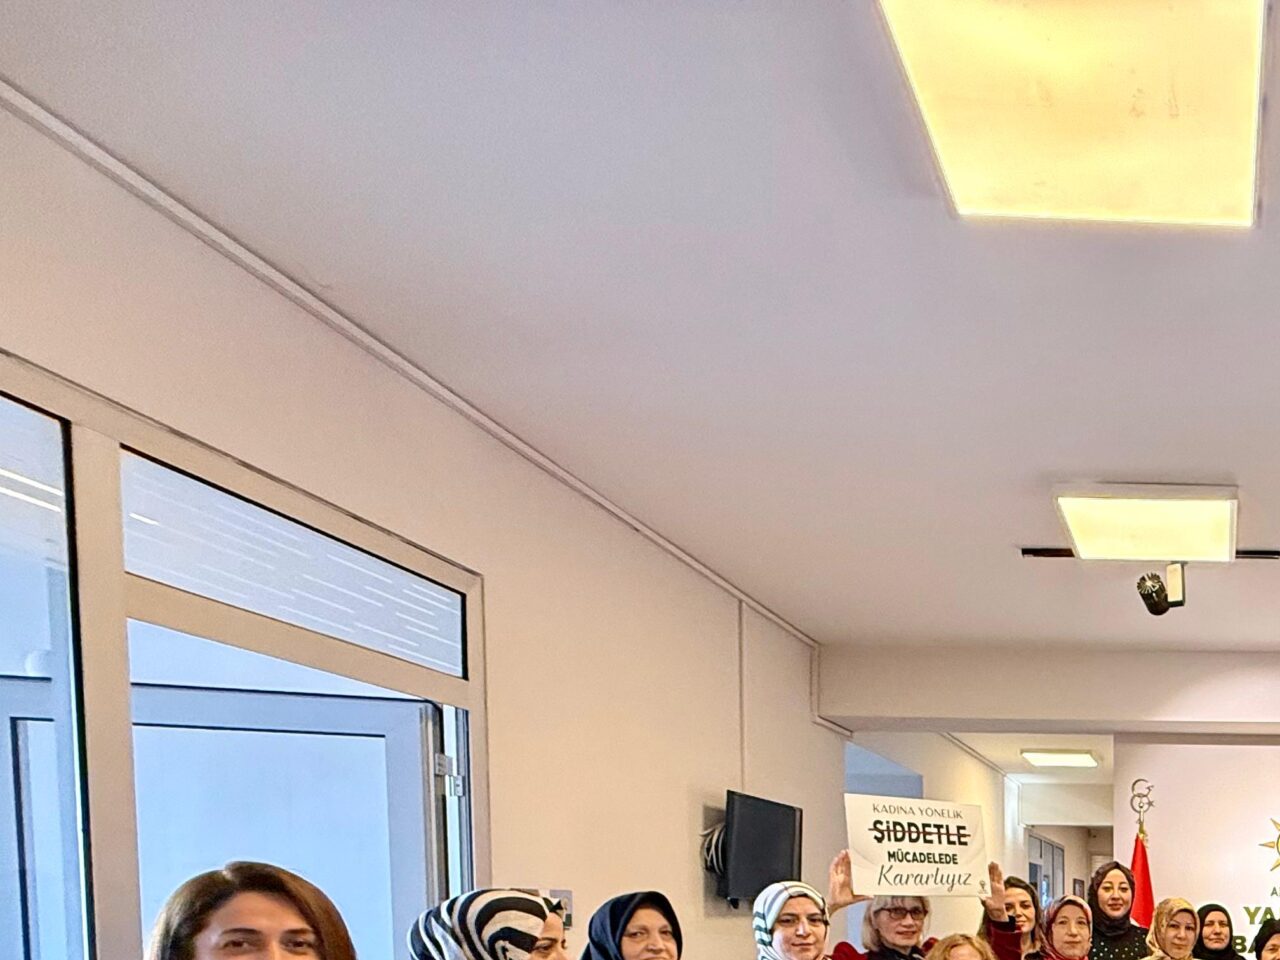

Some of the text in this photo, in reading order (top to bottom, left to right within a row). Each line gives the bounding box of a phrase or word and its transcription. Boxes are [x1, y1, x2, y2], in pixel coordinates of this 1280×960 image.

[872, 803, 916, 816] KADINA
[872, 819, 968, 846] ŞİDDETLE
[887, 849, 959, 865] MÜCADELEDE
[877, 864, 972, 892] Kararlıyız
